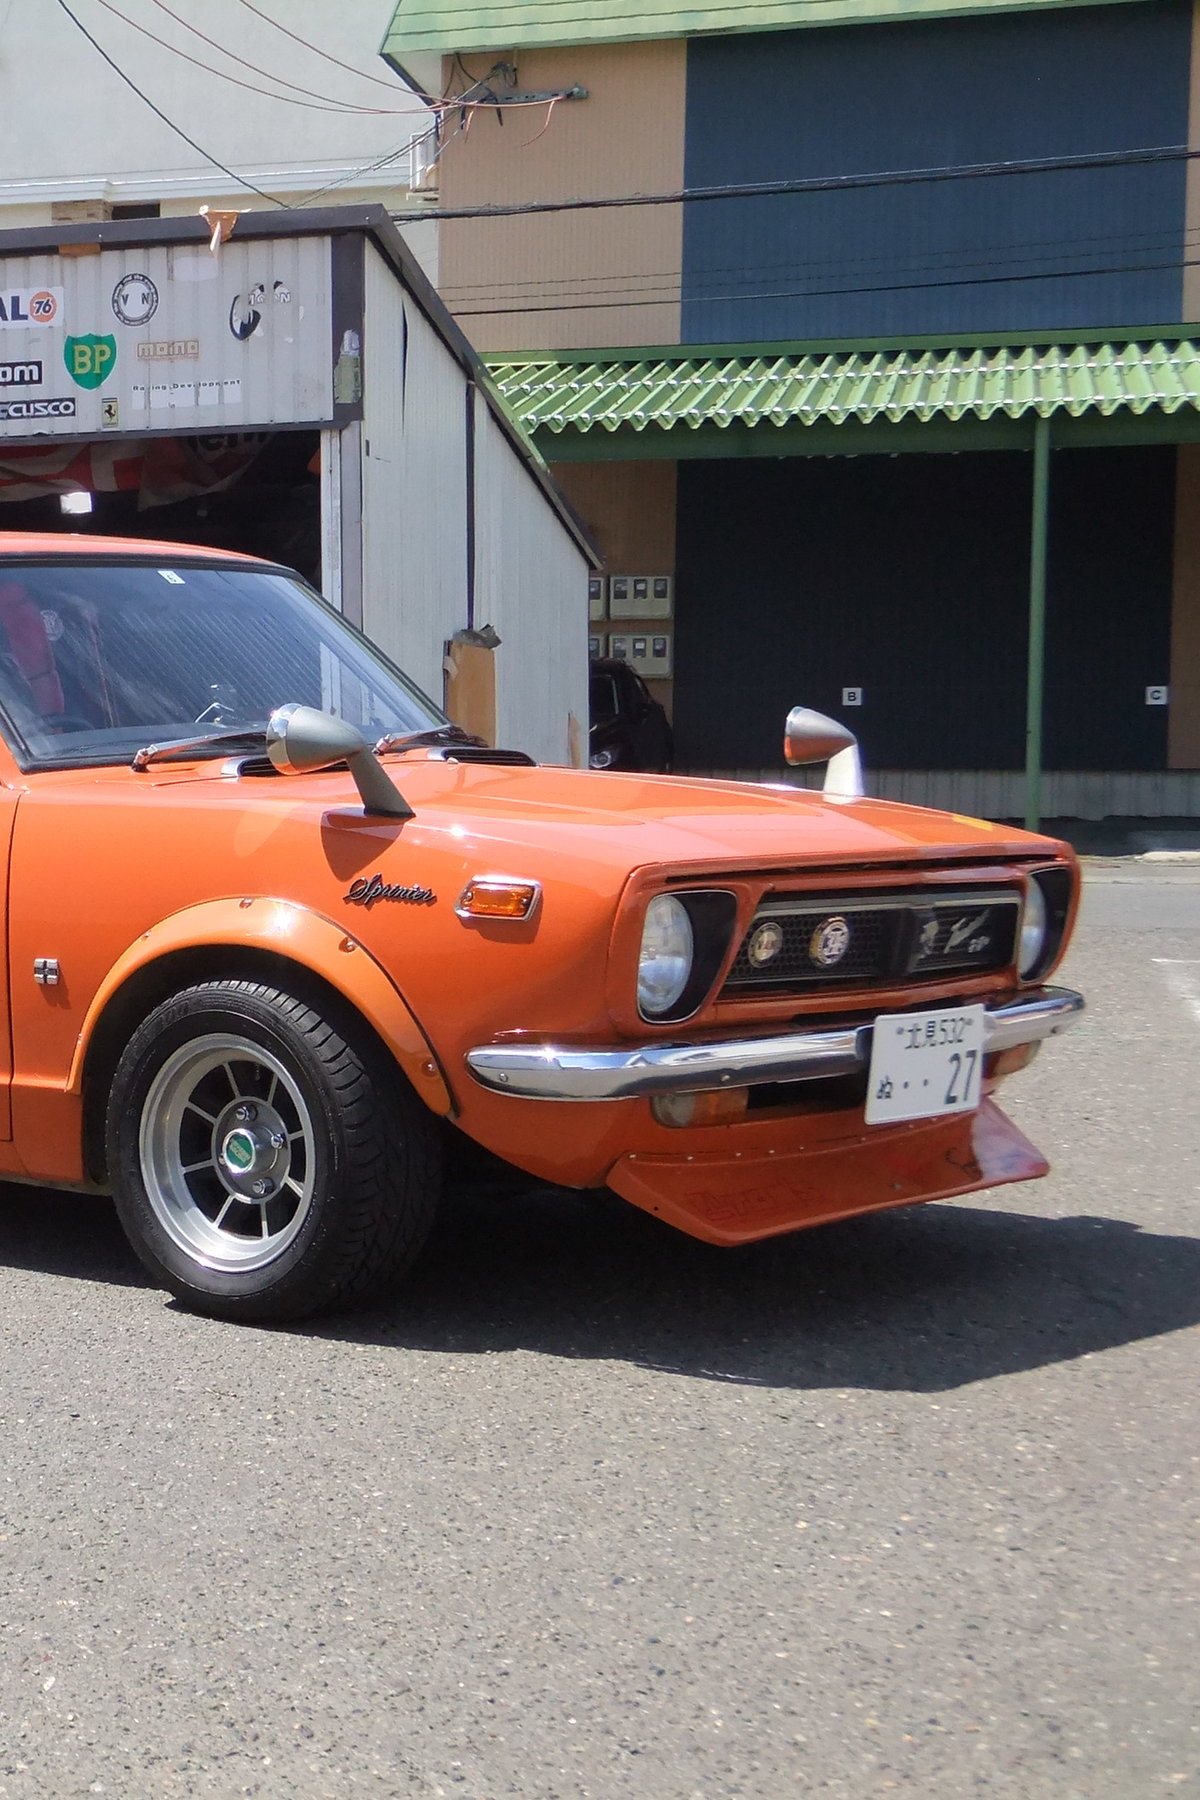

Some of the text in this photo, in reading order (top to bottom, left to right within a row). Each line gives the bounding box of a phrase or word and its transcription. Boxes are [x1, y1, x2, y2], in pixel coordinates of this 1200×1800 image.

[33, 298, 52, 315] 76
[72, 344, 112, 375] BP
[8, 401, 75, 417] CUSCO
[847, 691, 857, 702] B
[1150, 689, 1161, 701] C
[343, 872, 435, 907] Sprinter
[944, 1049, 978, 1105] 27
